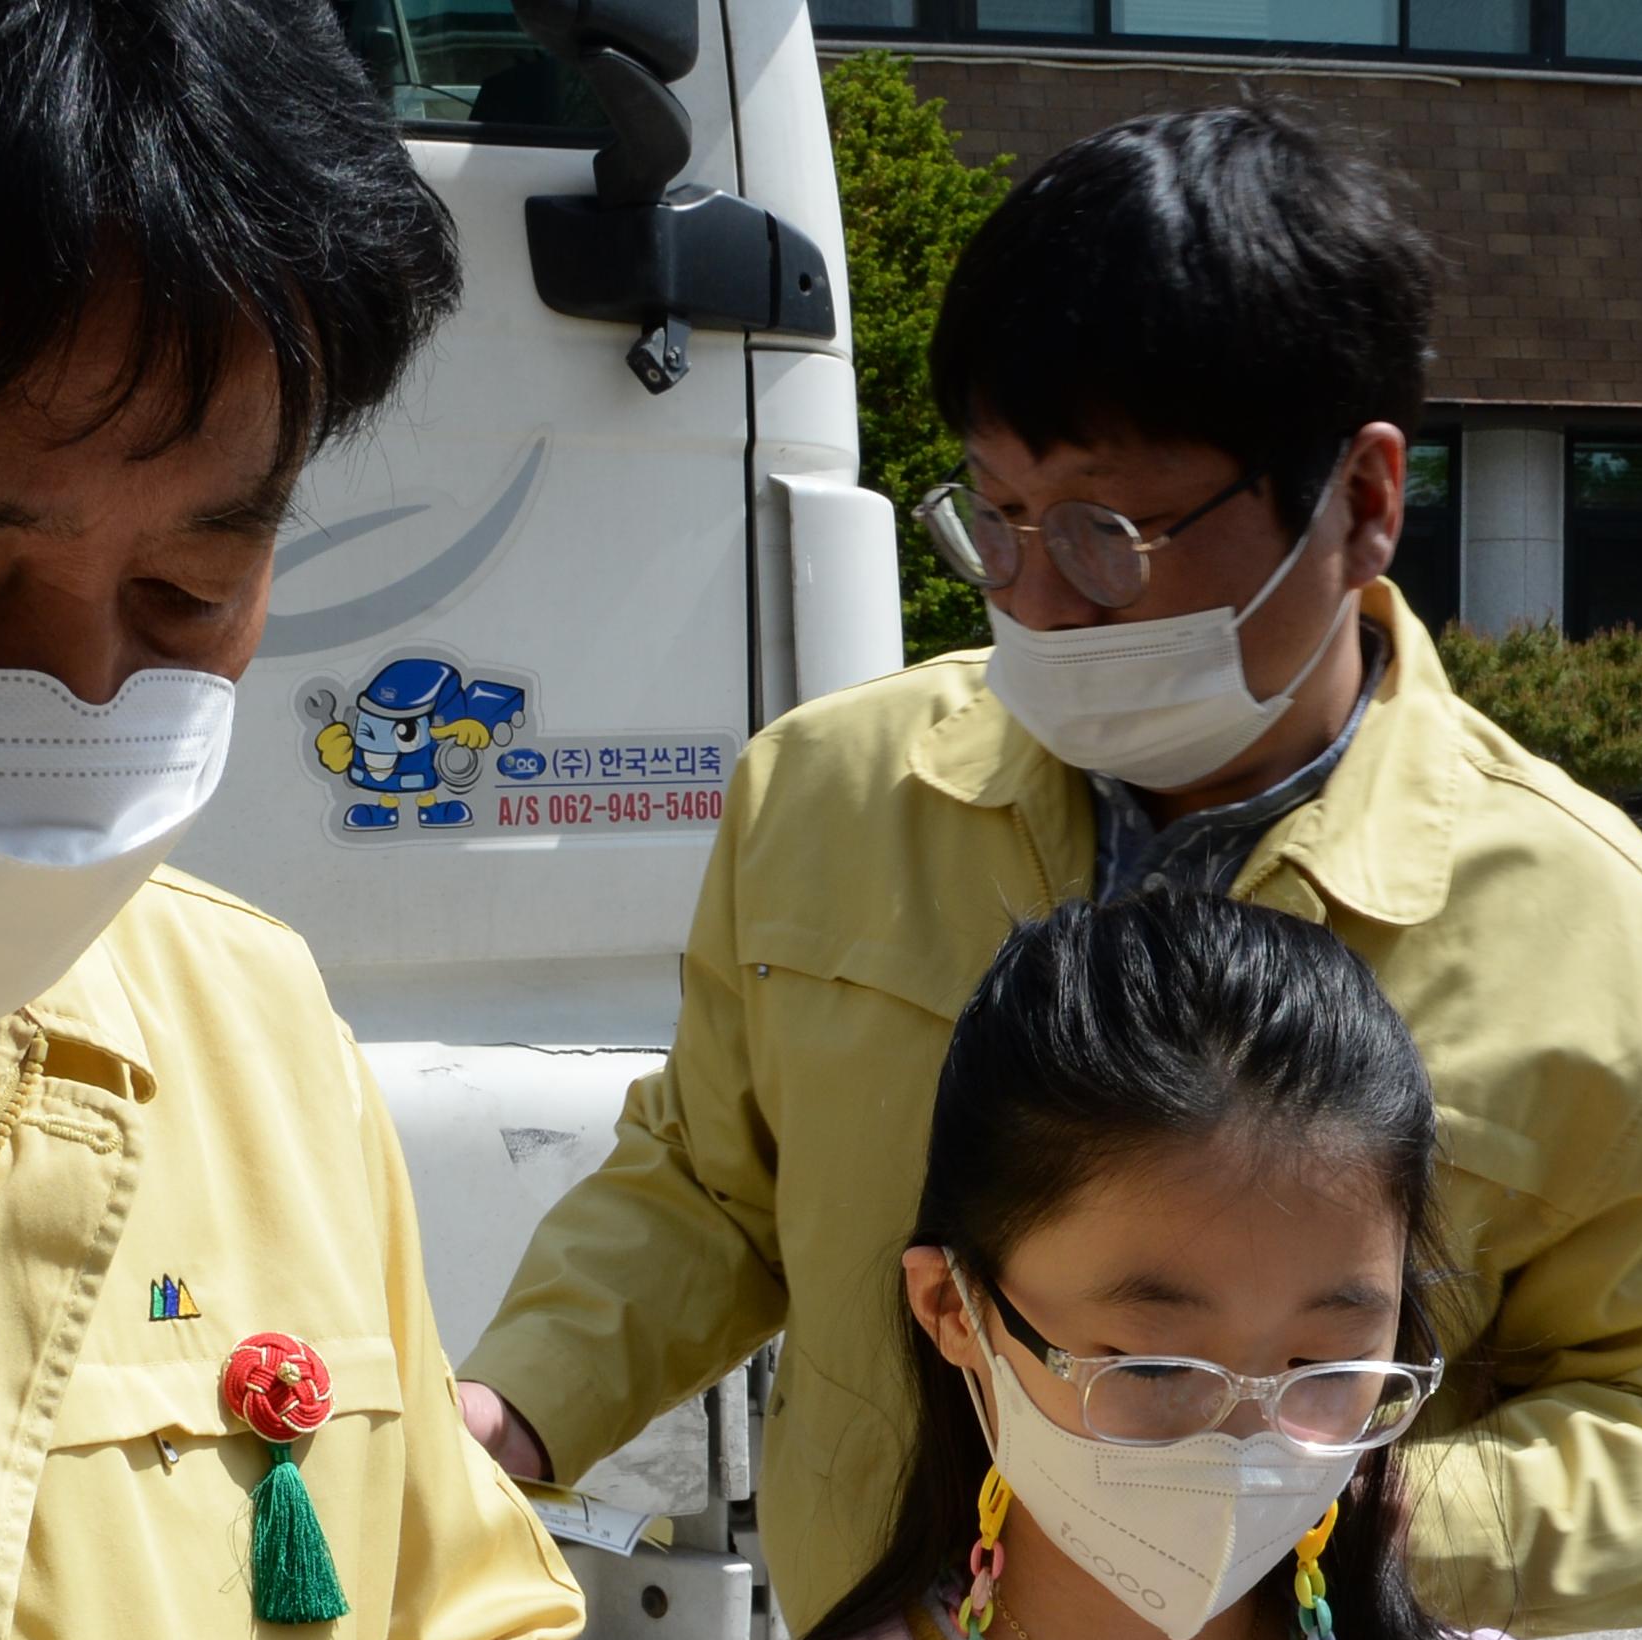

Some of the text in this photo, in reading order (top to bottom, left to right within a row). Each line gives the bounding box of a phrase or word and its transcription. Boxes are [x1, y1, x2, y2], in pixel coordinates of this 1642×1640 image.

[552, 747, 592, 779] (주)
[599, 746, 722, 779] 한국쓰리축
[498, 790, 723, 827] A/S 062-943-5460
